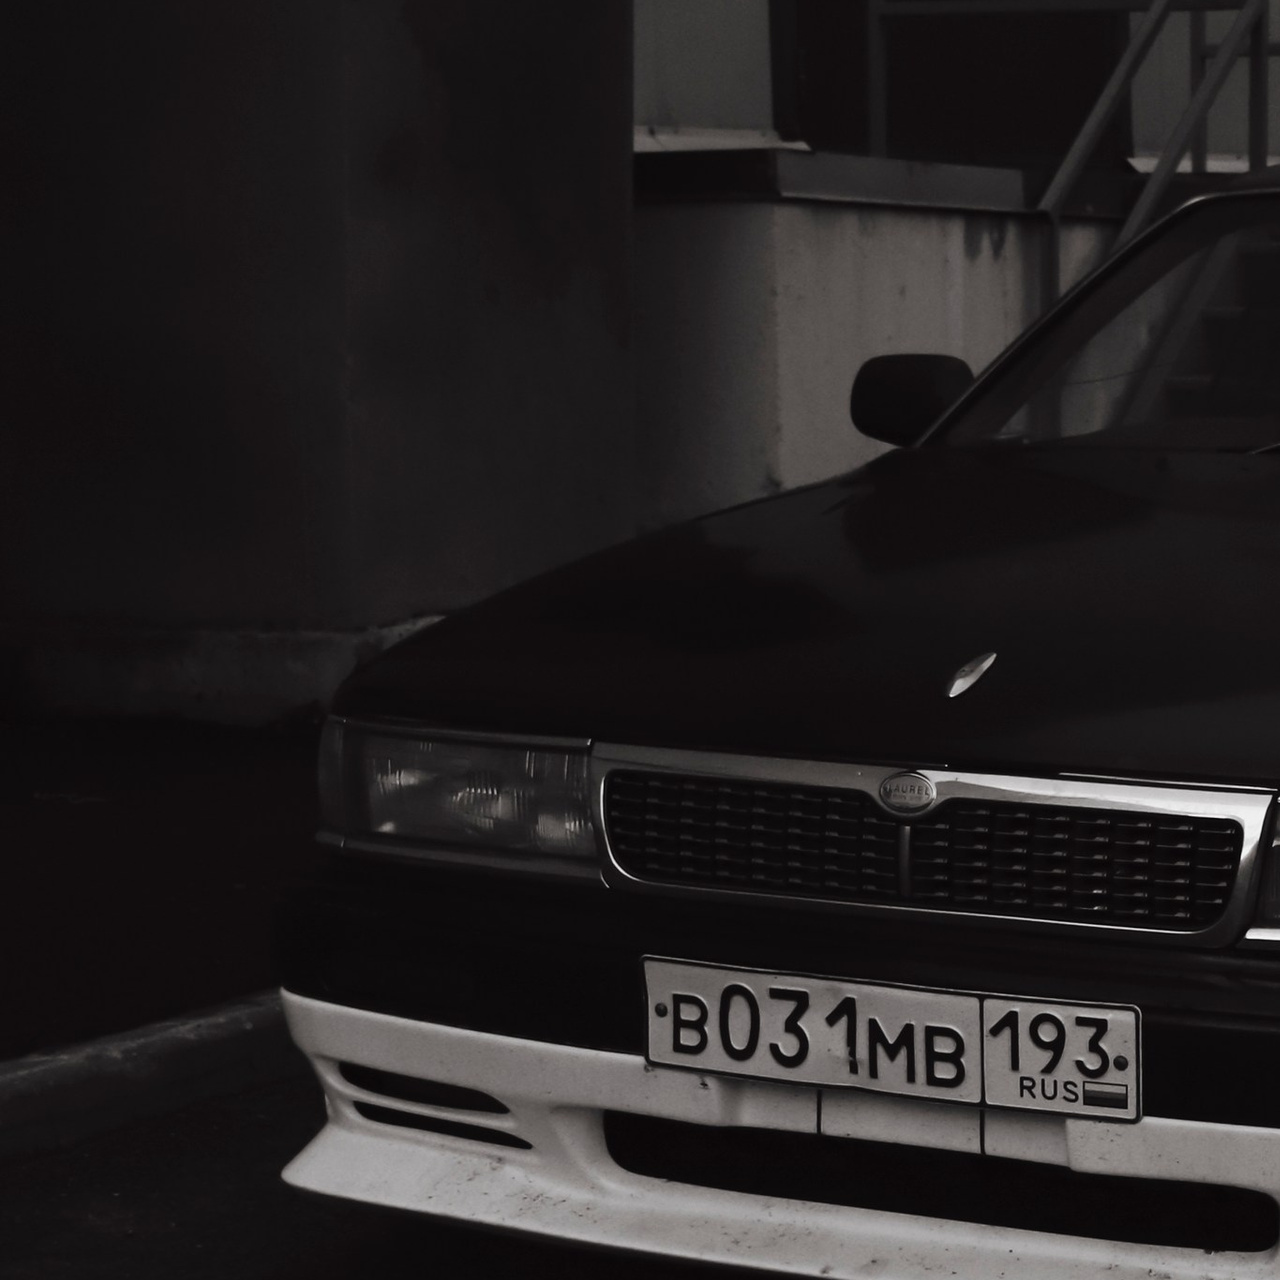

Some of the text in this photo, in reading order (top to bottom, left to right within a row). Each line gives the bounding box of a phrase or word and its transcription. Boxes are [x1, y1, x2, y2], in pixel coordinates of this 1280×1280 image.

[887, 784, 930, 796] LAUREL
[989, 1010, 1110, 1079] 193
[1019, 1076, 1079, 1103] RUS
